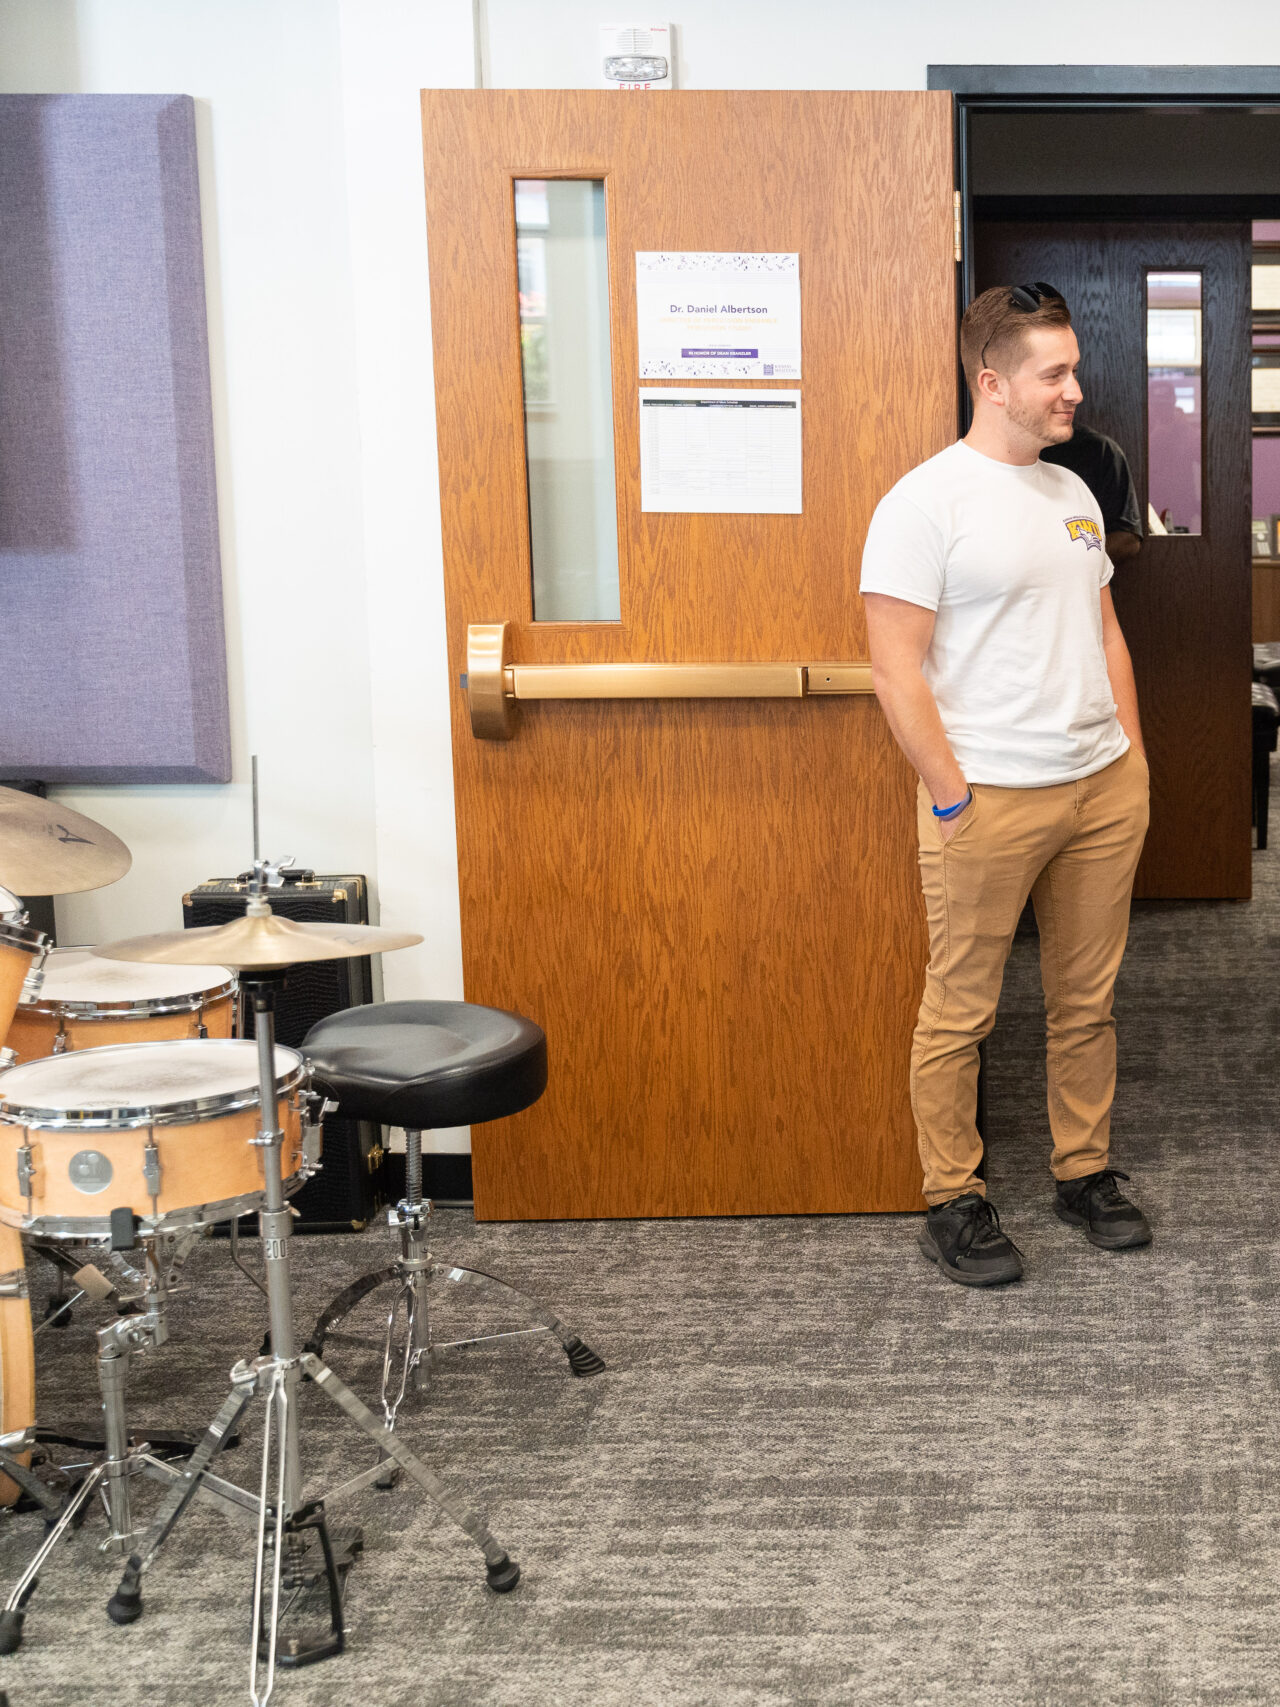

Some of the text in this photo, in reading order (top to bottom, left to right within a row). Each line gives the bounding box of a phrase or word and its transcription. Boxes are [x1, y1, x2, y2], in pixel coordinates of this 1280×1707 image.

[670, 304, 768, 314] Dr. Daniel Albertson
